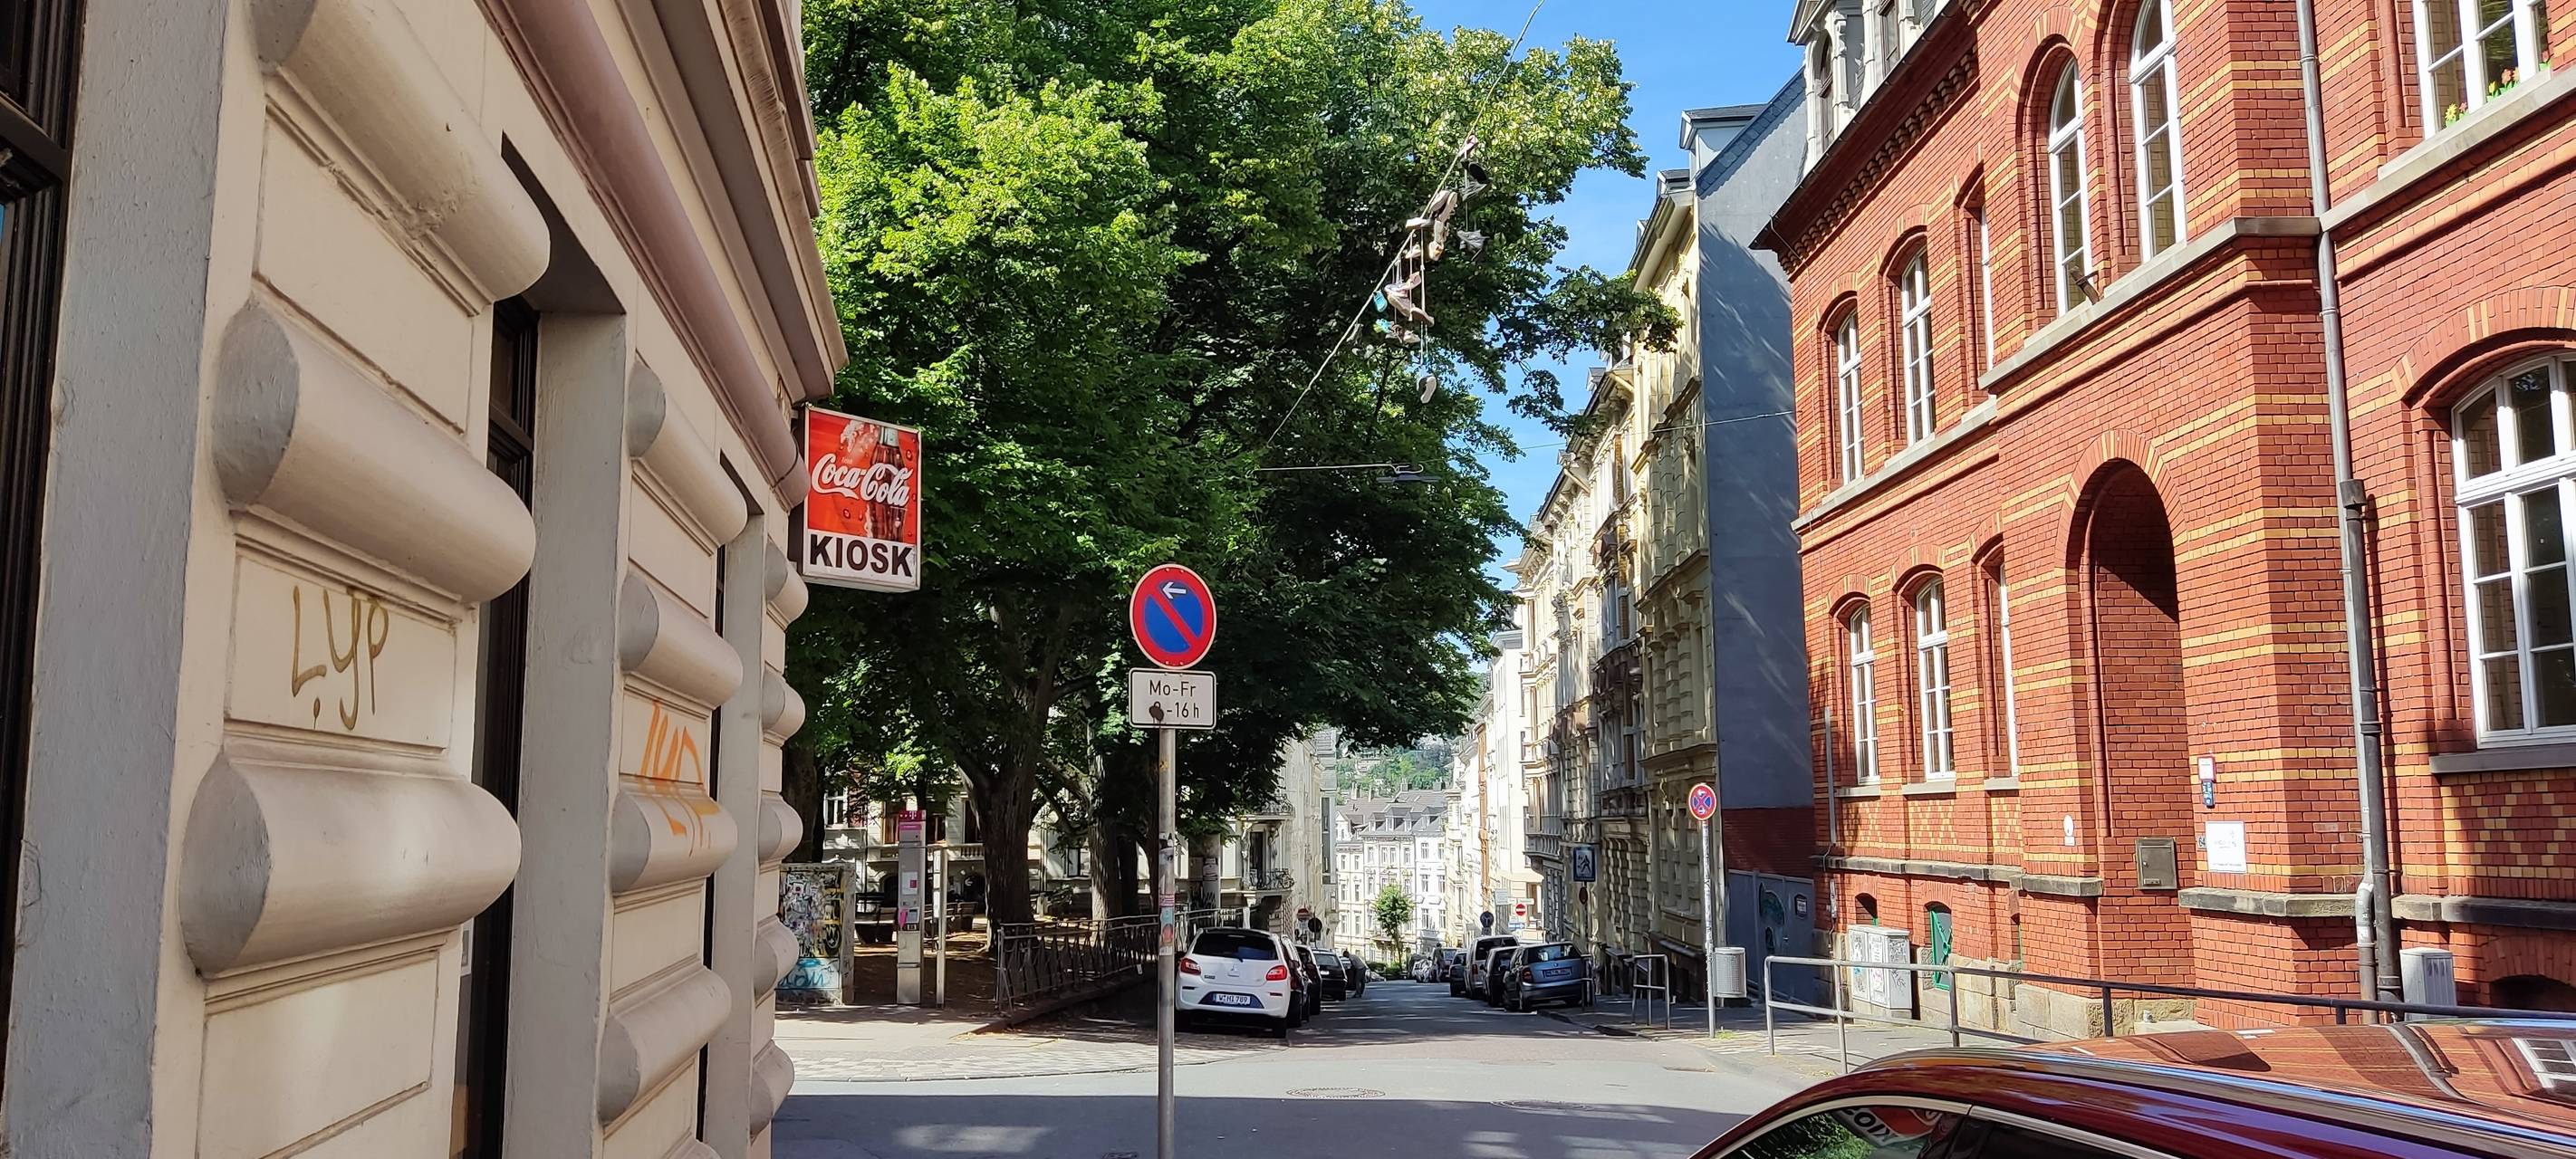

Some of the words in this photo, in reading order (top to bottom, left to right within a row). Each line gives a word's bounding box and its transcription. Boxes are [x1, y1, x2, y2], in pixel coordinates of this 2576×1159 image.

[812, 453, 914, 507] Coca-Cola
[809, 533, 913, 577] KIOSK
[1149, 679, 1197, 697] Mo-Fr
